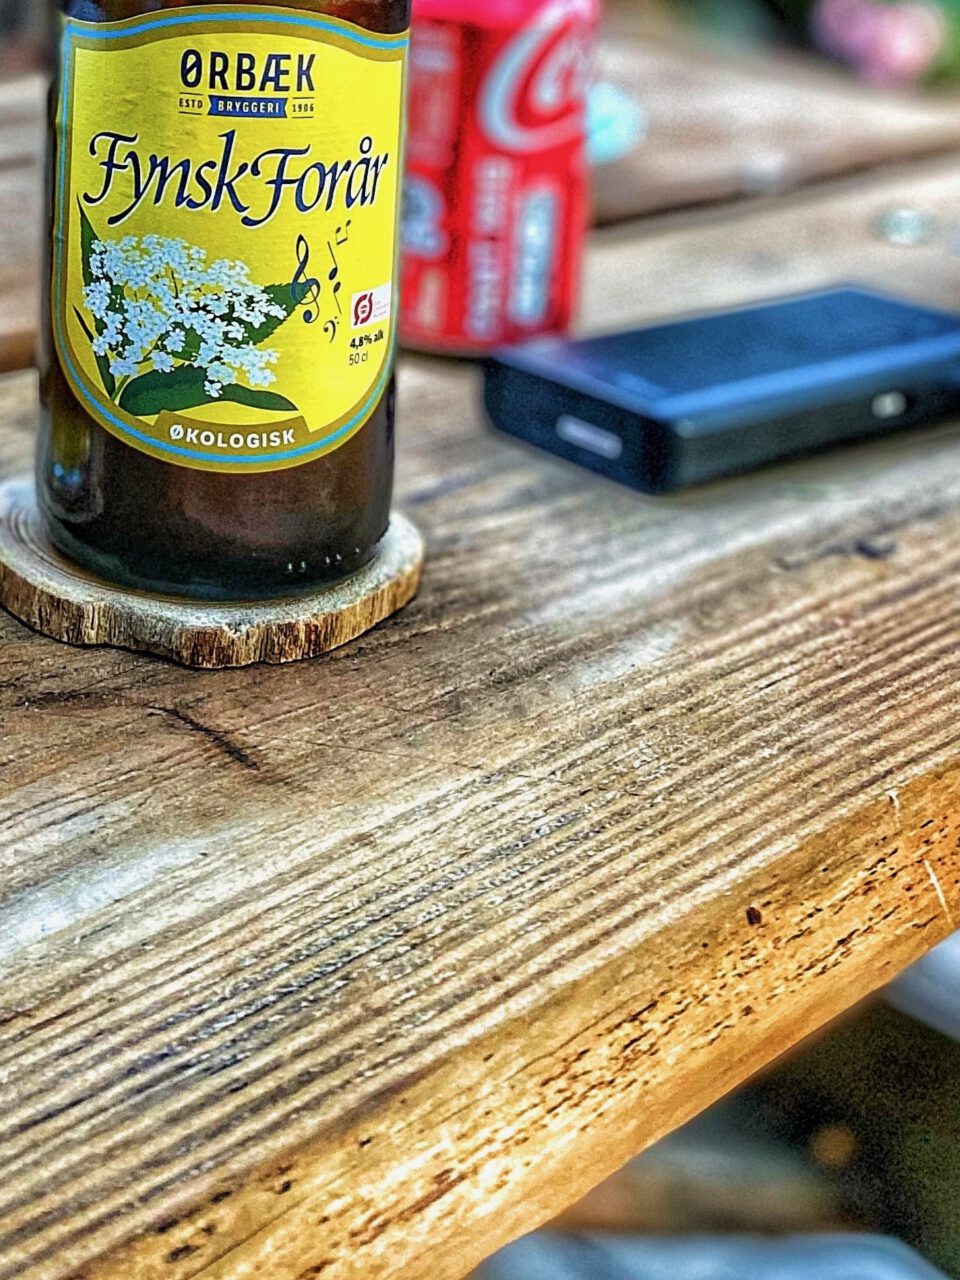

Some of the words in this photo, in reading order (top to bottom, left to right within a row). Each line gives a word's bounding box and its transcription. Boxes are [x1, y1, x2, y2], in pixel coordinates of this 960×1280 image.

[180, 49, 316, 92] ØRBÆK
[179, 98, 203, 110] ESTD
[218, 100, 279, 114] BRYGGERI
[292, 103, 315, 113] 1906
[349, 333, 373, 350] 4,8%
[349, 352, 360, 365] 50
[169, 424, 296, 448] ØKOLOGISK
